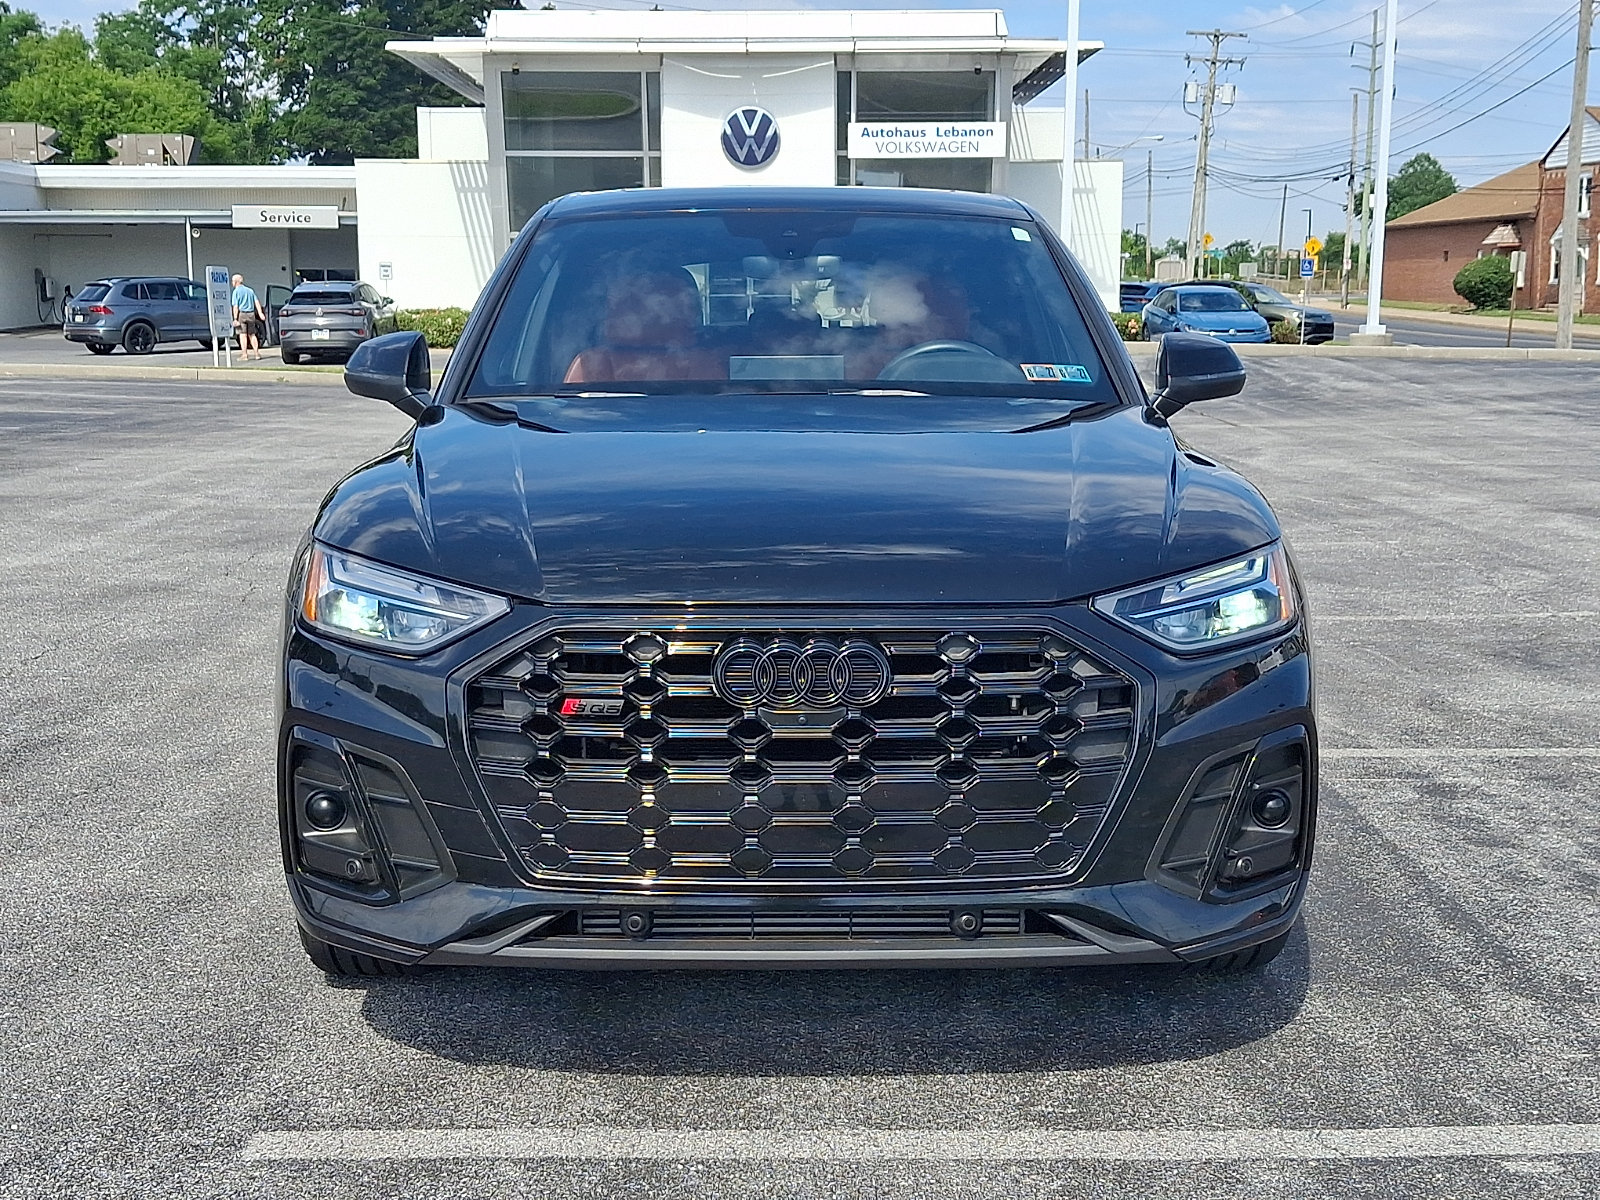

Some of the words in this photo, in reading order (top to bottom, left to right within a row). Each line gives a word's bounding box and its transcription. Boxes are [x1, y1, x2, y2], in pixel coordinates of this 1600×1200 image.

[861, 126, 926, 138] Autohaus
[936, 126, 994, 137] Lebanon
[875, 141, 979, 153] VOLKSWAGEN
[260, 210, 311, 223] Service
